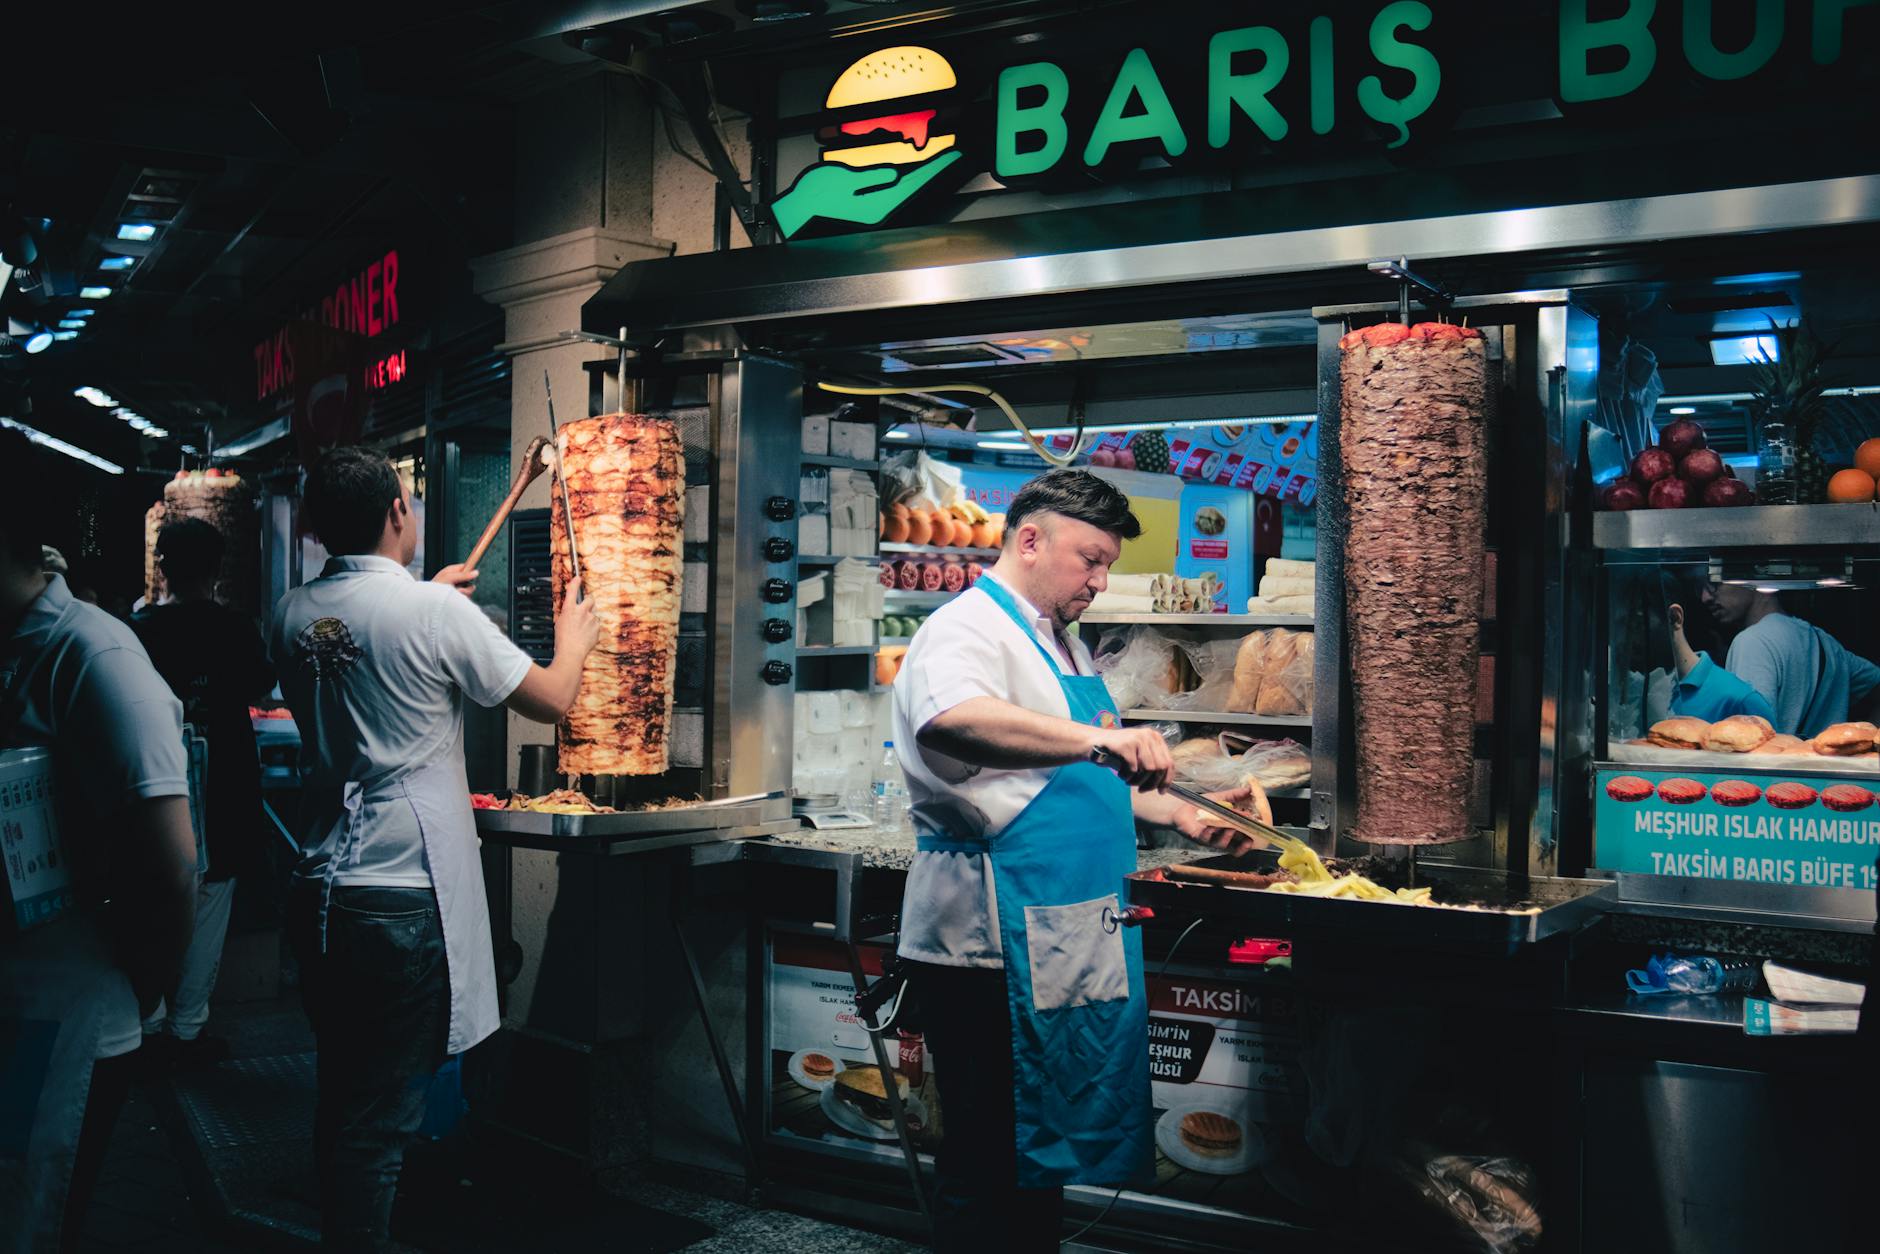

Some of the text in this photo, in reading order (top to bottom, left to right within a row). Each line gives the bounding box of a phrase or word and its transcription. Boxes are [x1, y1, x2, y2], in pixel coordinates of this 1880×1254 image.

[995, 0, 1442, 178] BARIŞ
[1635, 810, 1719, 841] MEŞHUR
[1724, 814, 1783, 841] ISLAK
[1650, 848, 1727, 880] TAKSİM
[1801, 856, 1855, 888] BÜFE
[1171, 986, 1263, 1015] TAKSİM
